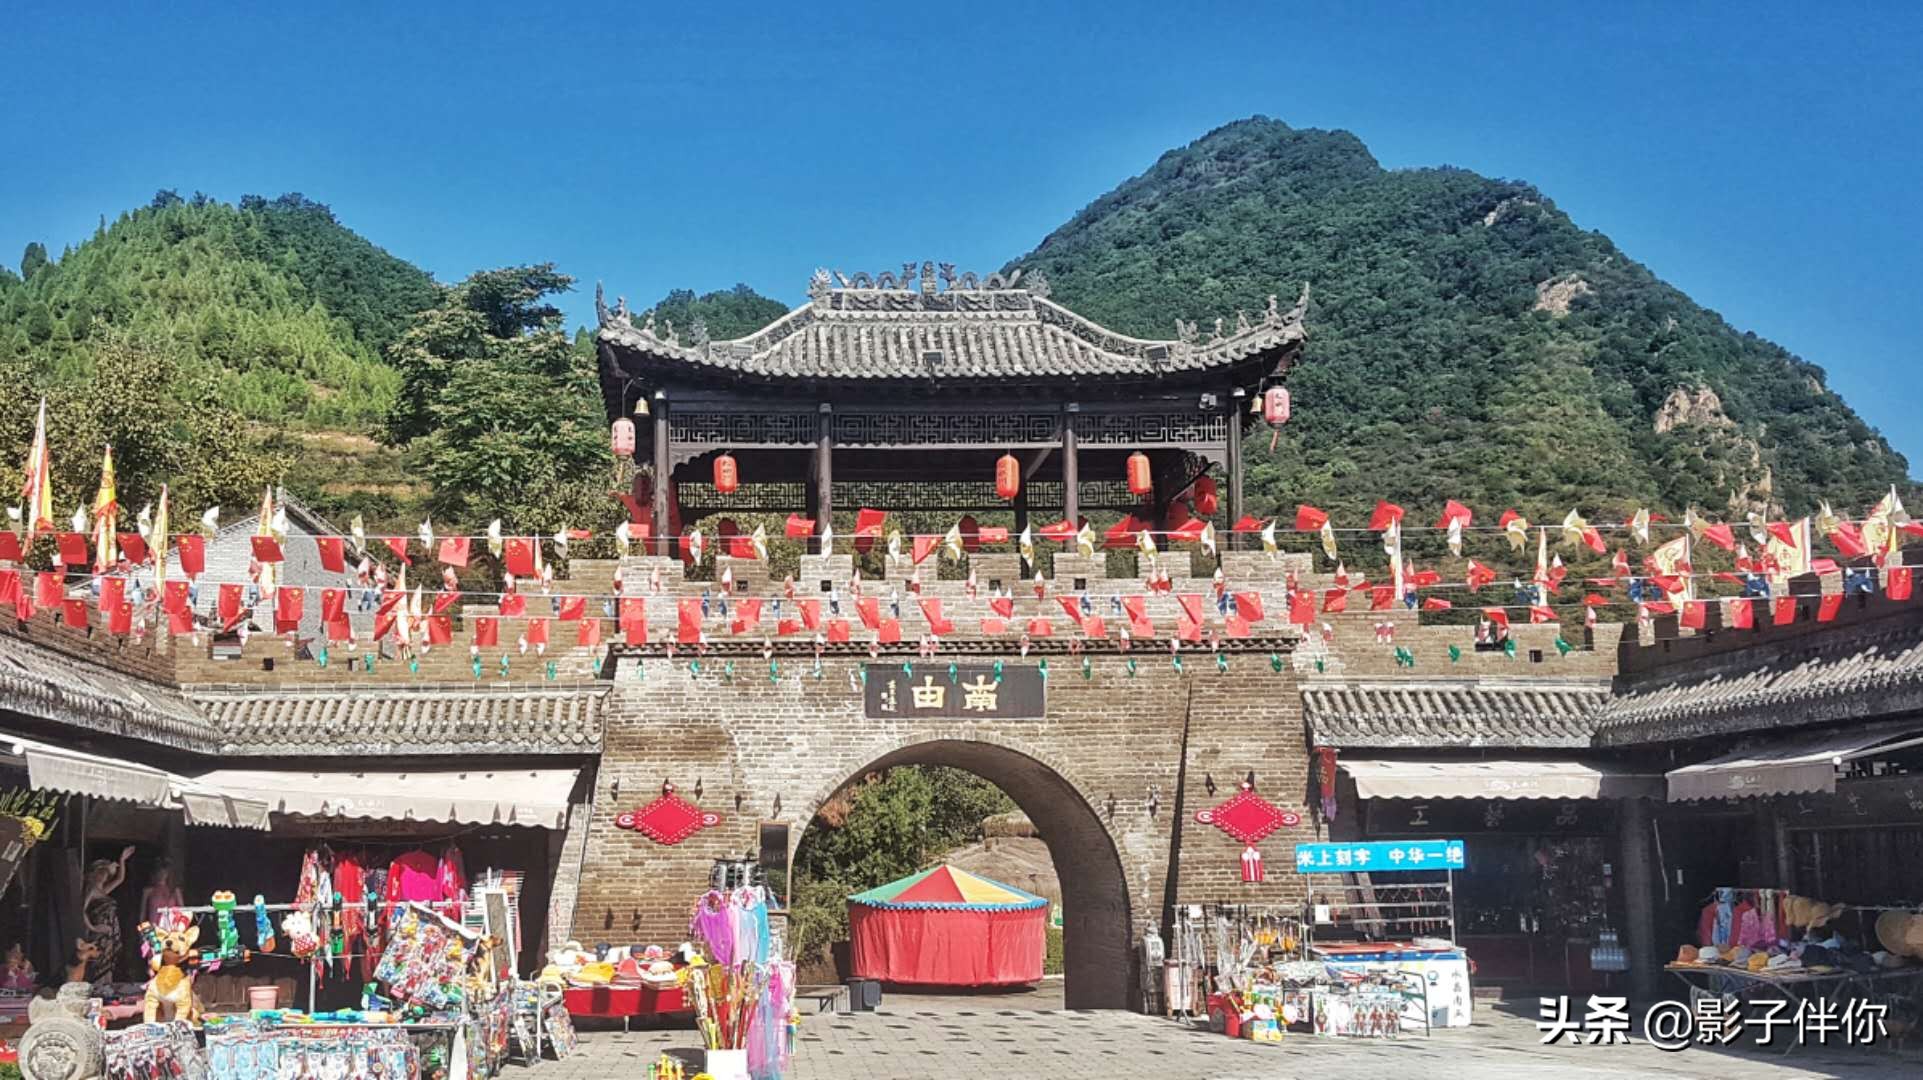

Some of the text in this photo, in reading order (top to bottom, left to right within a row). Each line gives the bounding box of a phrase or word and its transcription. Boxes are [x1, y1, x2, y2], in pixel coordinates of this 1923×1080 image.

[1297, 846, 1464, 867] 米上刻字 中华一绝
